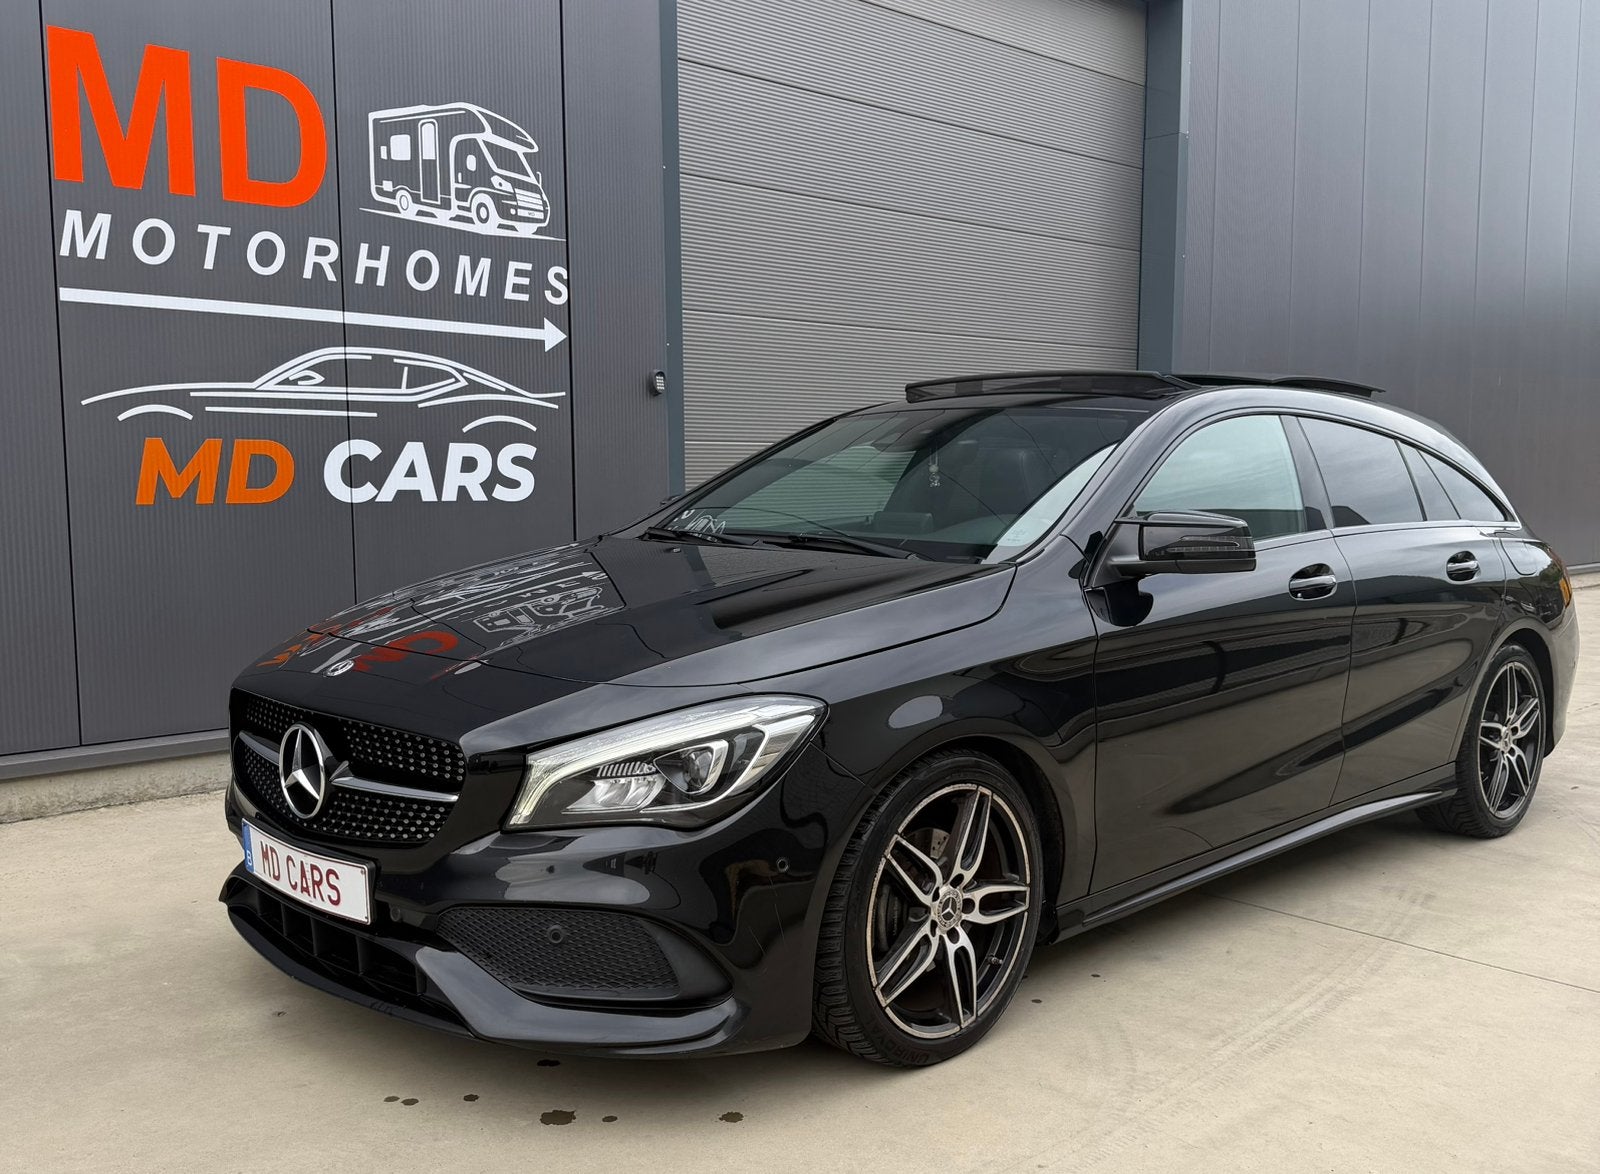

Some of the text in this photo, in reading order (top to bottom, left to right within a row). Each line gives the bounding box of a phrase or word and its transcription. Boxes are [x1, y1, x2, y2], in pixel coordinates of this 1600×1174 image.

[46, 24, 328, 208] MD
[59, 209, 569, 305] MOTORHOMES
[135, 437, 537, 505] MD CARS
[260, 840, 342, 907] MD CARS
